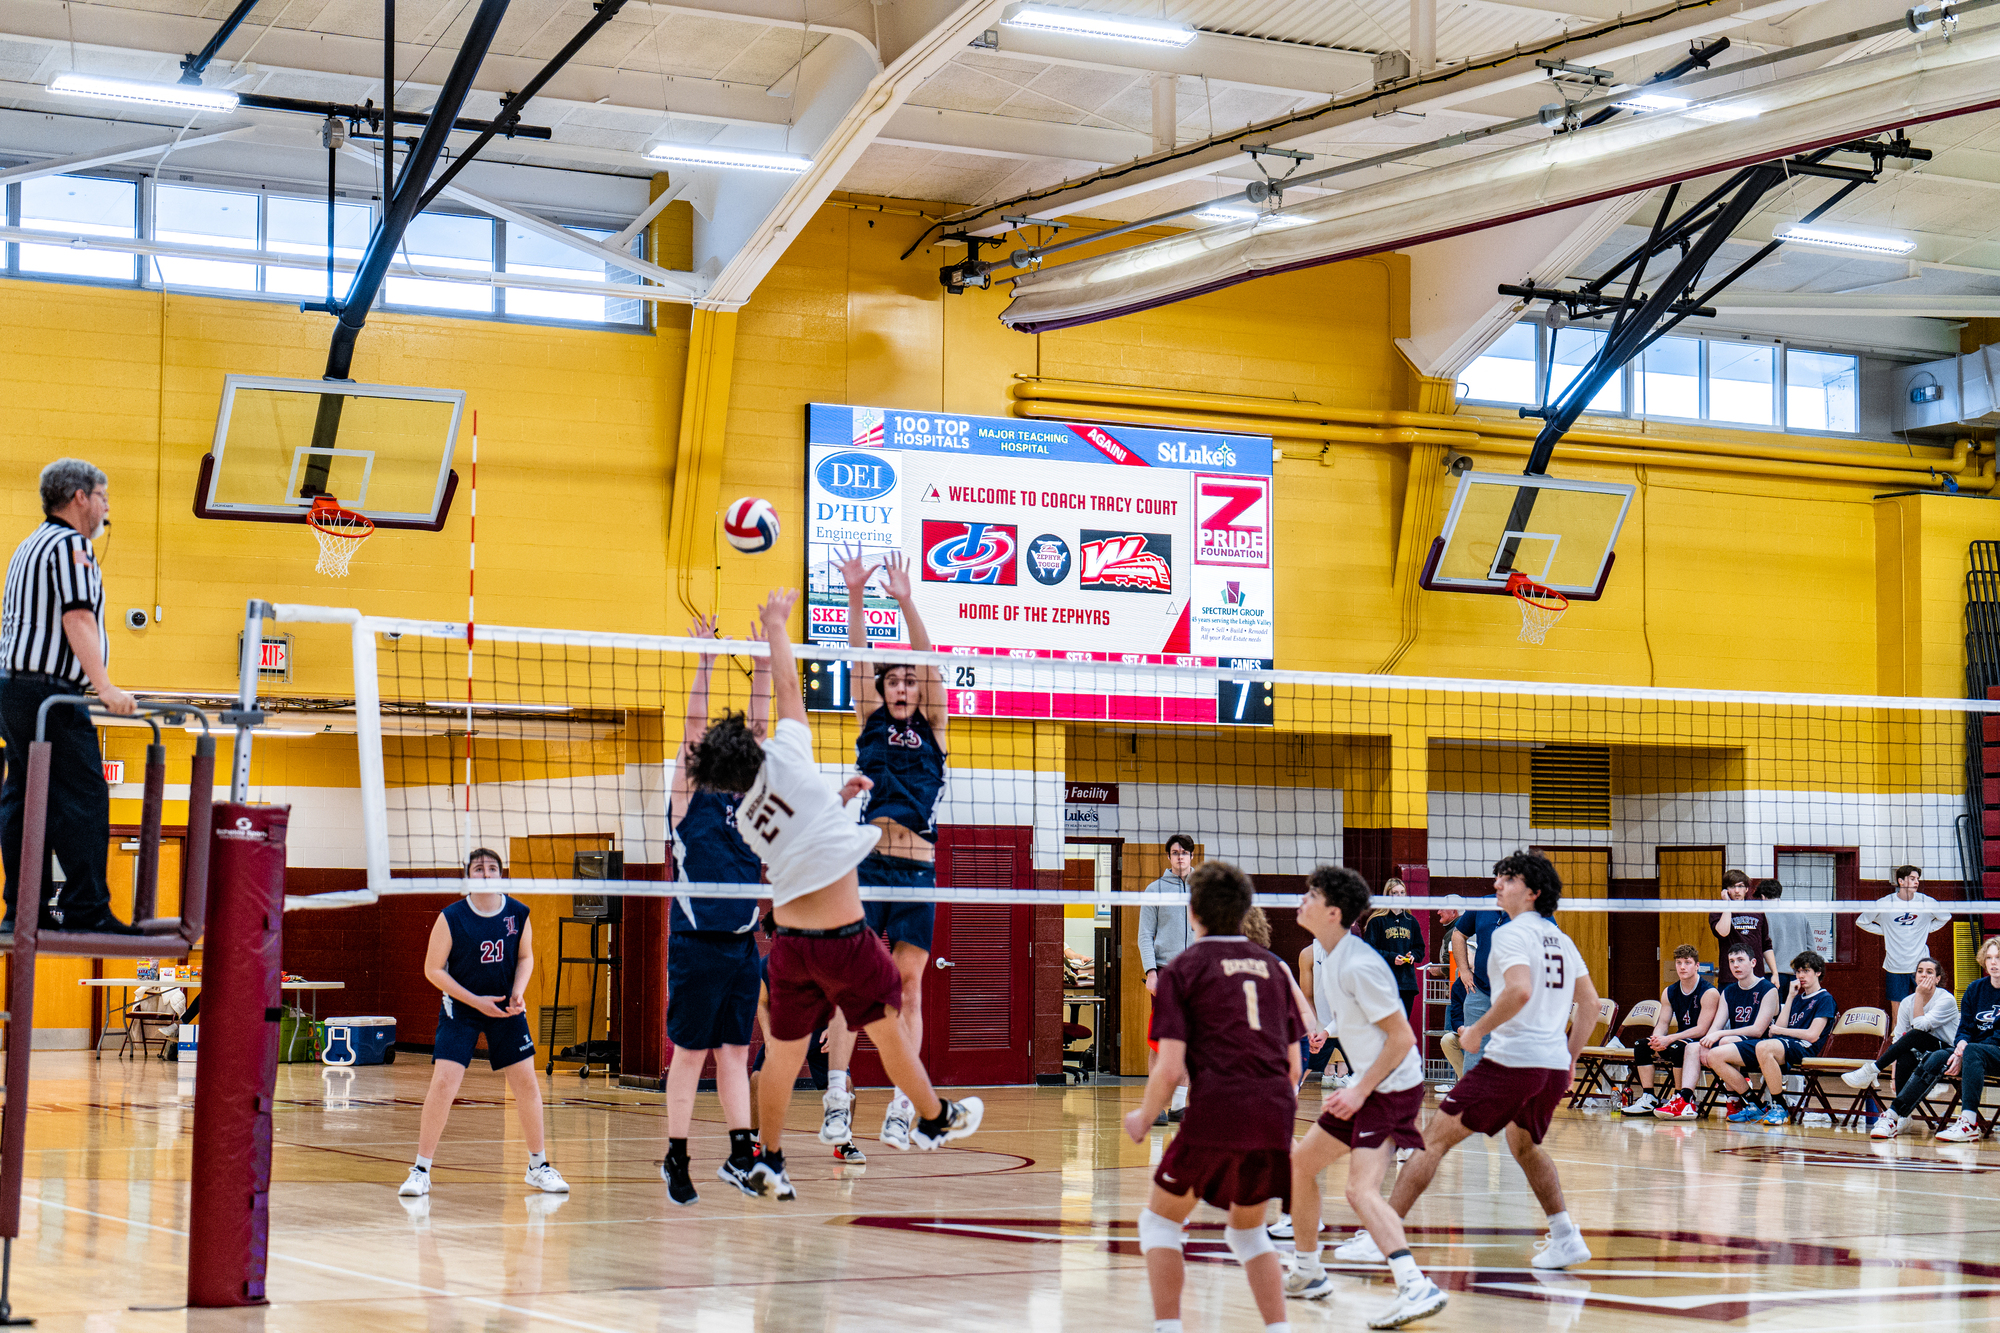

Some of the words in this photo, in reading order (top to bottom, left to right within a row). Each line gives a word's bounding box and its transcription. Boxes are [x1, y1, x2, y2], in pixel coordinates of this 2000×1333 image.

[894, 416, 930, 433] 100
[934, 419, 970, 436] TOP
[978, 428, 1015, 440] MAJOR
[1018, 431, 1068, 444] TEACHING
[894, 432, 970, 449] HOSPITALS
[1001, 442, 1050, 454] HOSPITAL
[1087, 428, 1127, 462] AGAIN!
[830, 463, 882, 489] DEI
[949, 486, 1016, 505] WELCOME
[1020, 490, 1036, 506] TO
[1042, 492, 1086, 510] COACH
[1090, 496, 1132, 513] TRACY
[1136, 498, 1178, 516] COURT
[816, 502, 894, 524] D'HUY
[816, 526, 892, 545] Engineering
[1201, 529, 1263, 549] PRIDE
[1200, 547, 1263, 558] FOUNDATION
[812, 608, 896, 625] SKETON
[959, 603, 998, 620] HOME
[1004, 606, 1019, 621] OF
[1024, 606, 1048, 623] THE
[1052, 608, 1110, 626] ZEPHYRS
[1202, 607, 1238, 616] SPECTRUM
[1240, 609, 1264, 617] GROUP
[818, 626, 891, 636] CONSTTION
[258, 644, 280, 667] XIT
[956, 666, 976, 687] 25
[956, 692, 976, 714] 13
[1232, 680, 1250, 720] 7
[101, 764, 119, 780] XIT
[1071, 786, 1109, 801] Facility
[480, 938, 504, 964] 21
[1243, 980, 1262, 1030] 1
[1735, 1006, 1752, 1022] 22
[1683, 1010, 1690, 1025] 4
